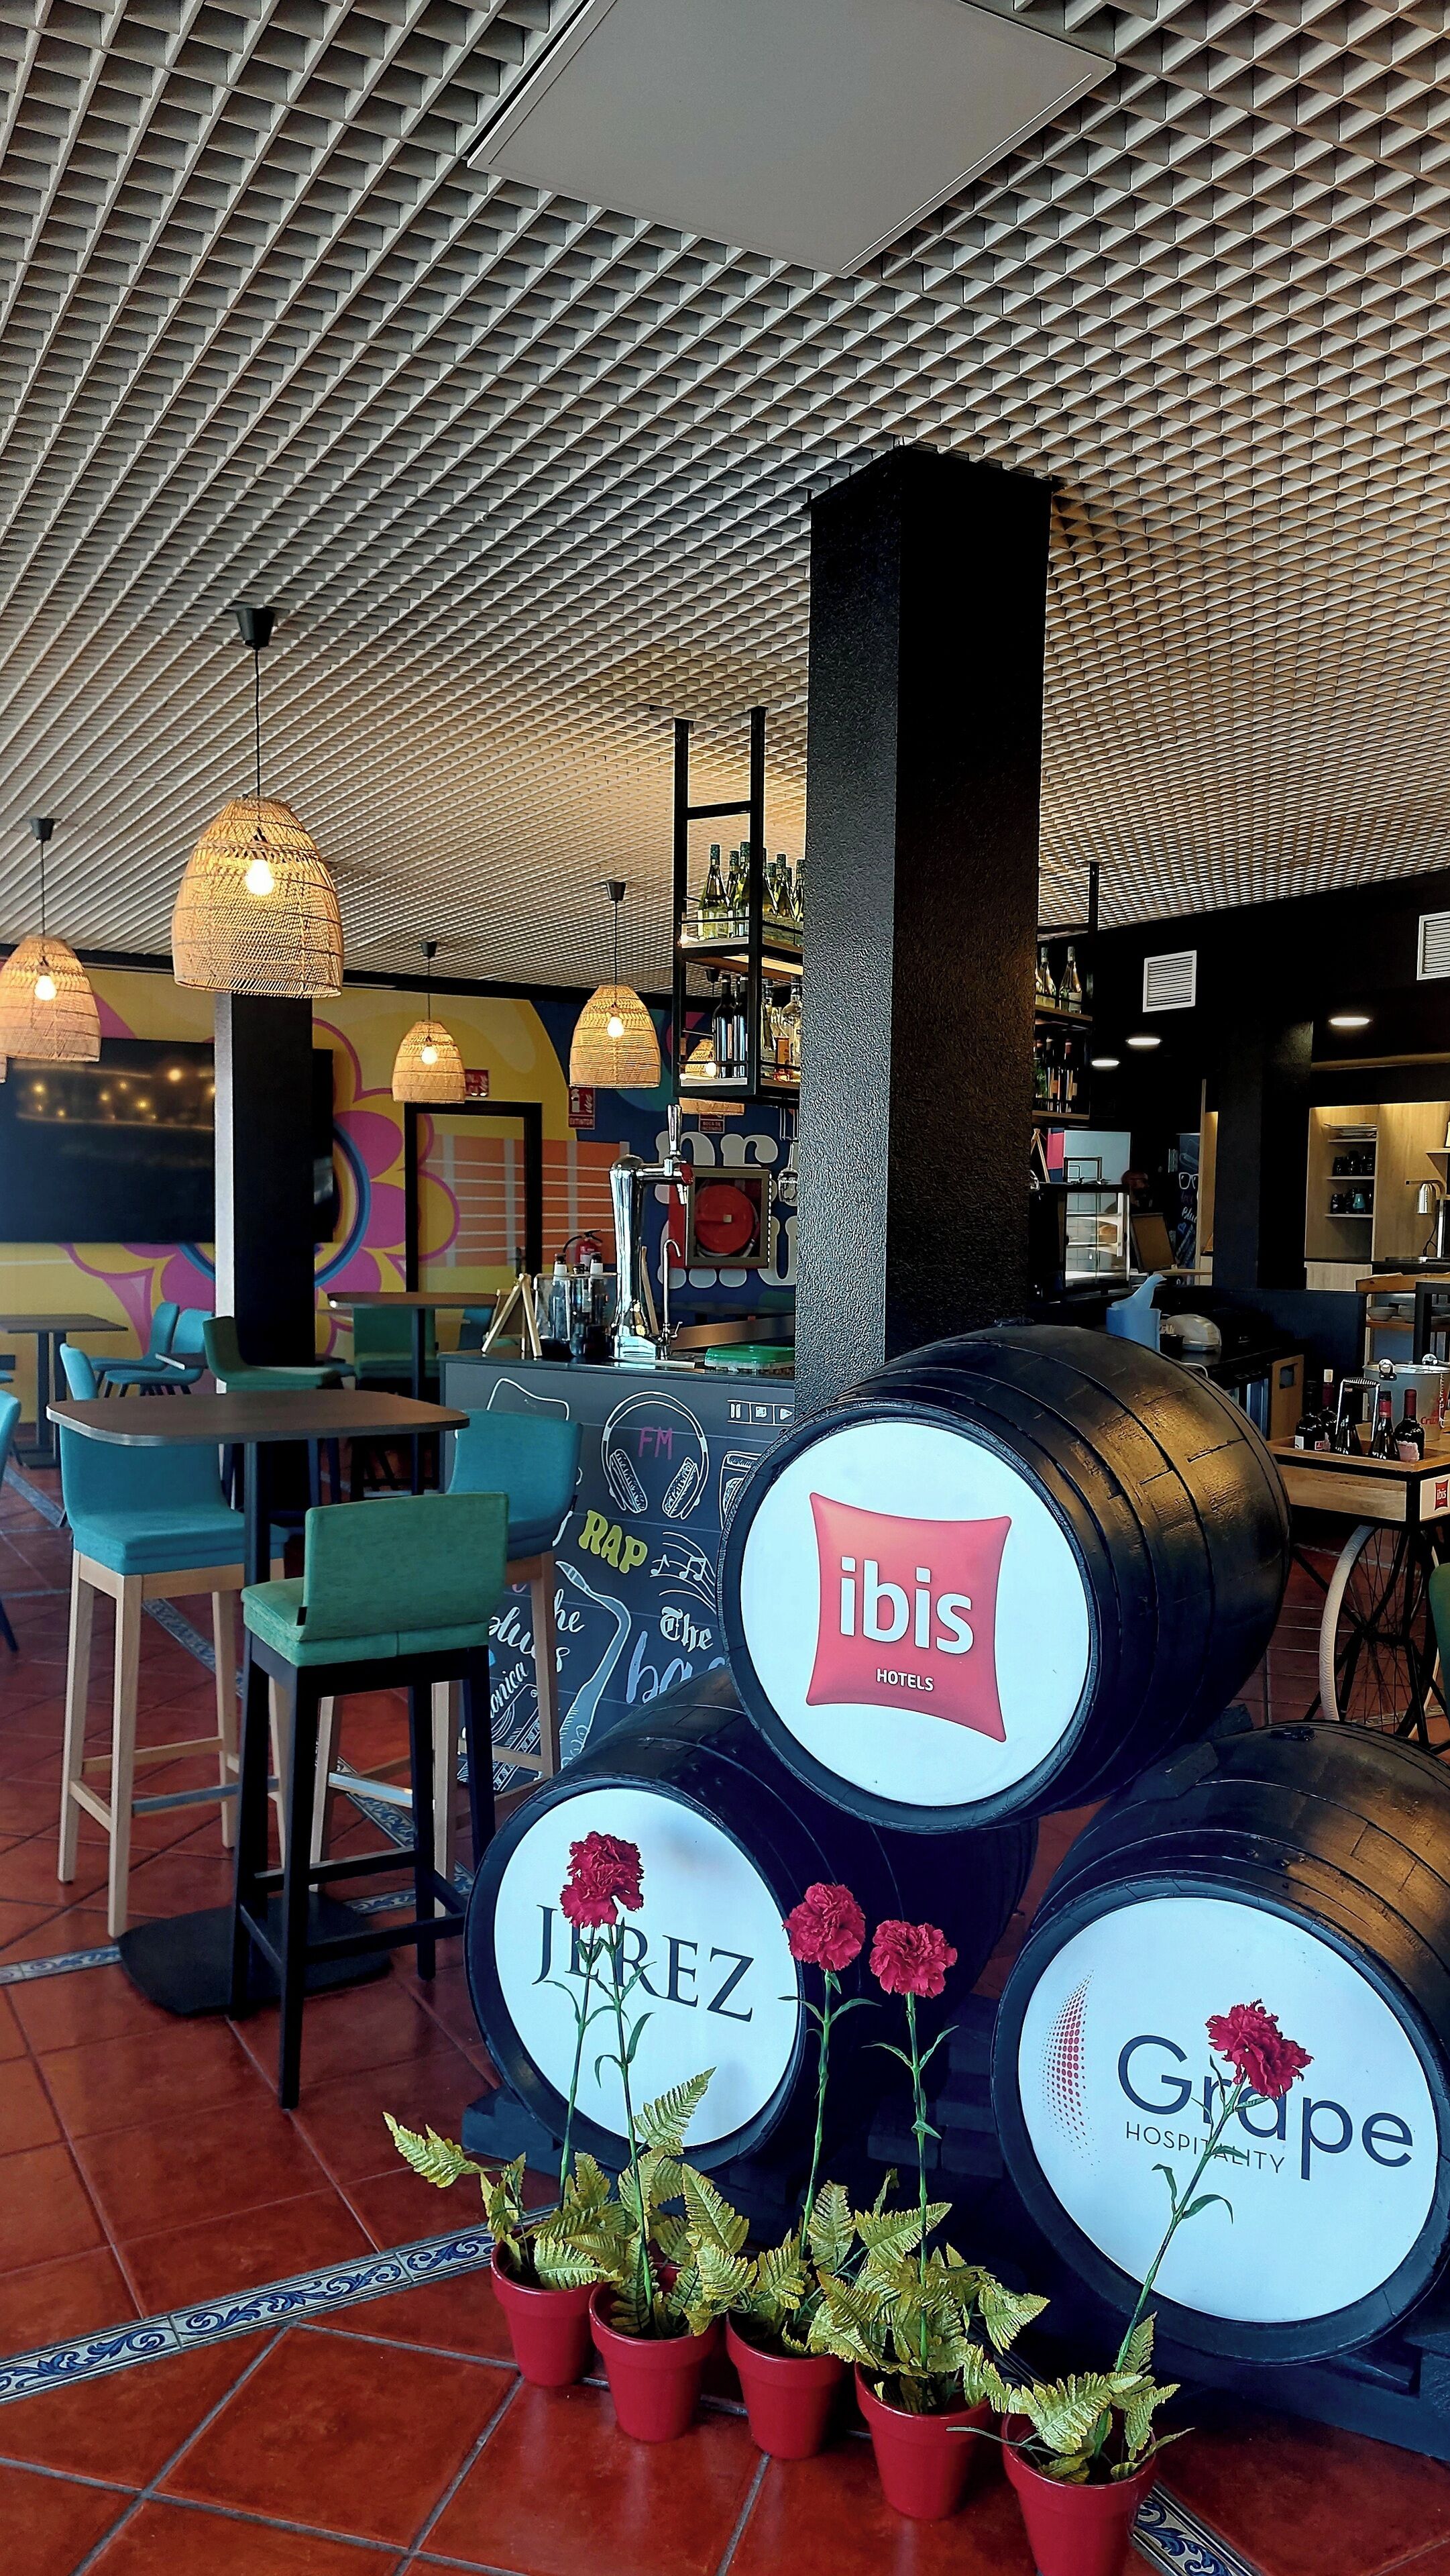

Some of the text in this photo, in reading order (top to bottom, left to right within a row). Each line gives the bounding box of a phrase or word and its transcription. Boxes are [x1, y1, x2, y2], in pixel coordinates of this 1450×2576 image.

[638, 1426, 673, 1460] FM
[578, 1509, 648, 1574] RAP
[554, 1588, 585, 1633] he
[660, 1606, 714, 1654] The
[840, 1555, 974, 1655] ibis
[876, 1667, 935, 1693] HOTELS
[531, 1904, 755, 2023] JEREZ
[1117, 2034, 1414, 2182] Grape
